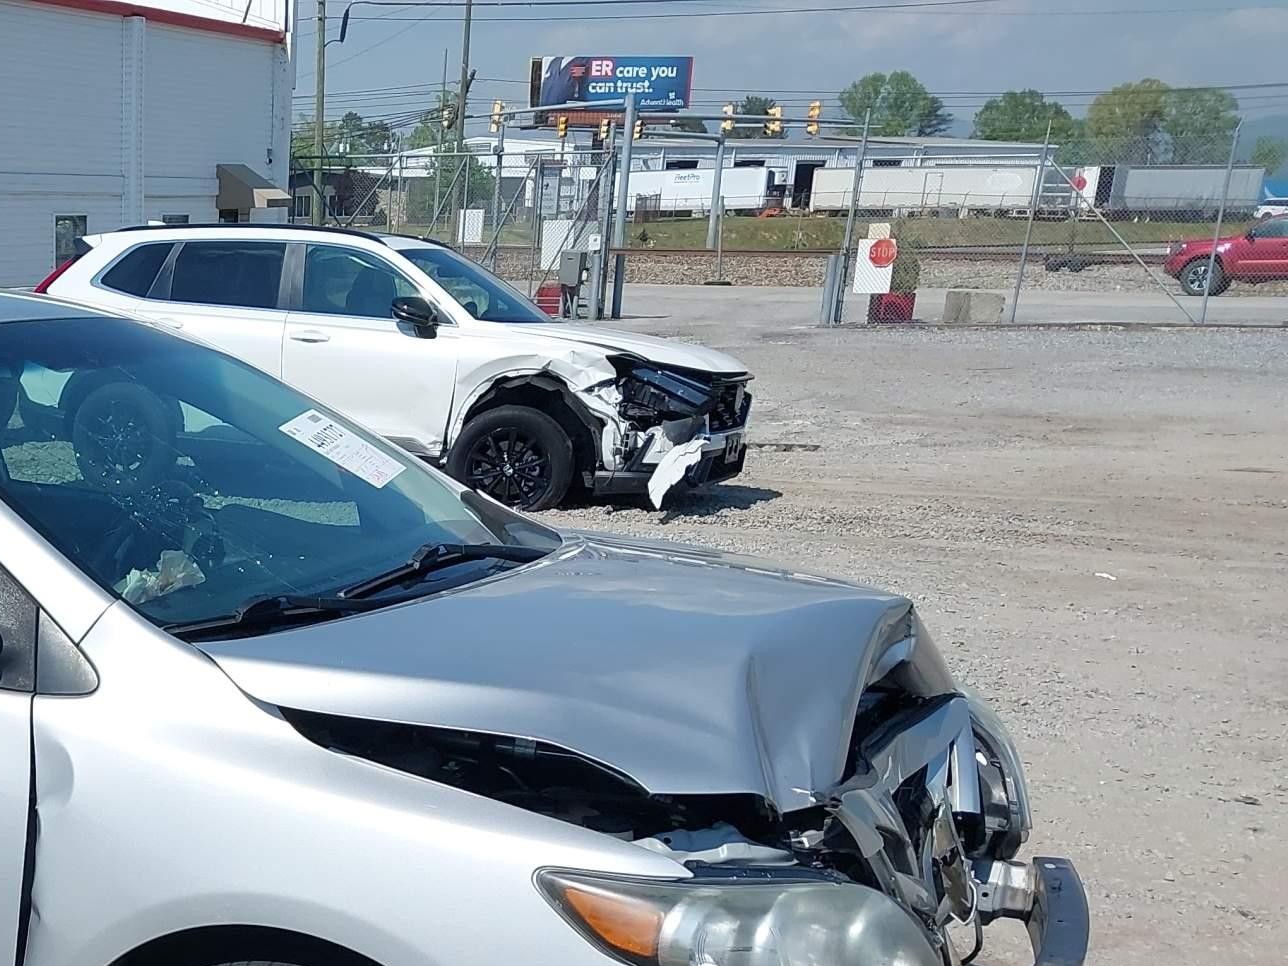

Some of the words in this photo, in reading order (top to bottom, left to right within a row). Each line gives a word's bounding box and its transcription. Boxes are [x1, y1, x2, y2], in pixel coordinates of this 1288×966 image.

[591, 60, 613, 76] ER
[616, 66, 648, 78] care
[651, 66, 677, 80] you
[588, 81, 613, 93] can
[616, 80, 654, 93] trust.
[870, 247, 895, 258] STOP
